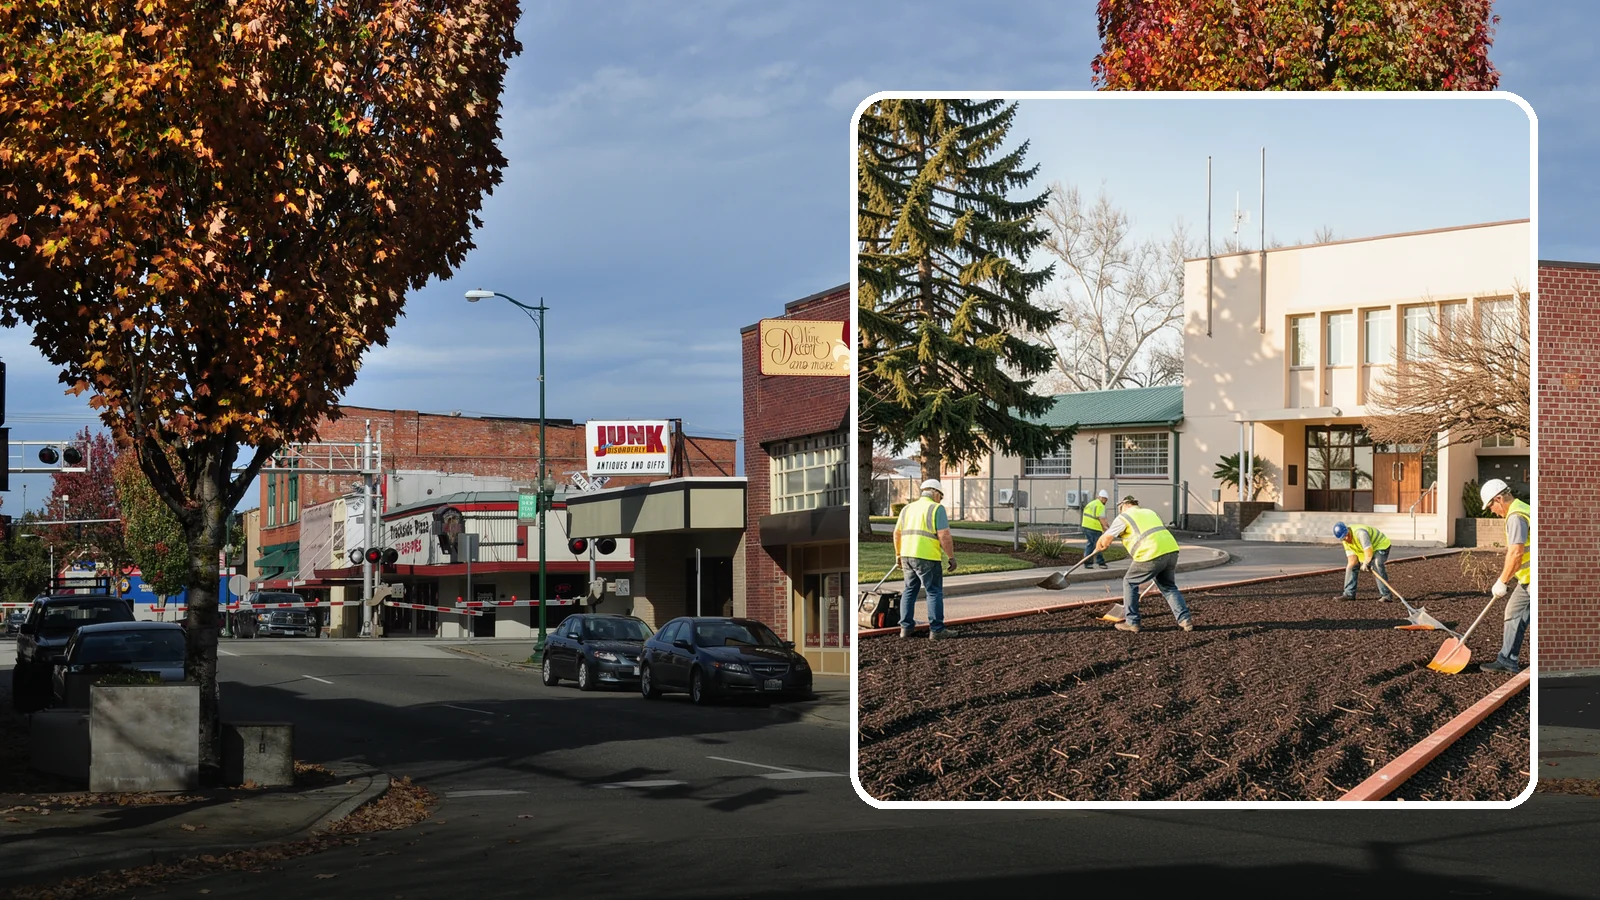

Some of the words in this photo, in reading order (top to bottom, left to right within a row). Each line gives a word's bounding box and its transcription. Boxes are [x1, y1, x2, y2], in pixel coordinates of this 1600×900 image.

[765, 327, 831, 365] Decor
[595, 425, 664, 457] JUNK
[607, 446, 646, 454] DISORDERLY
[597, 461, 628, 470] ANTIQUES
[631, 461, 644, 470] AND
[647, 460, 665, 469] GIFTS
[414, 519, 429, 535] Pizza
